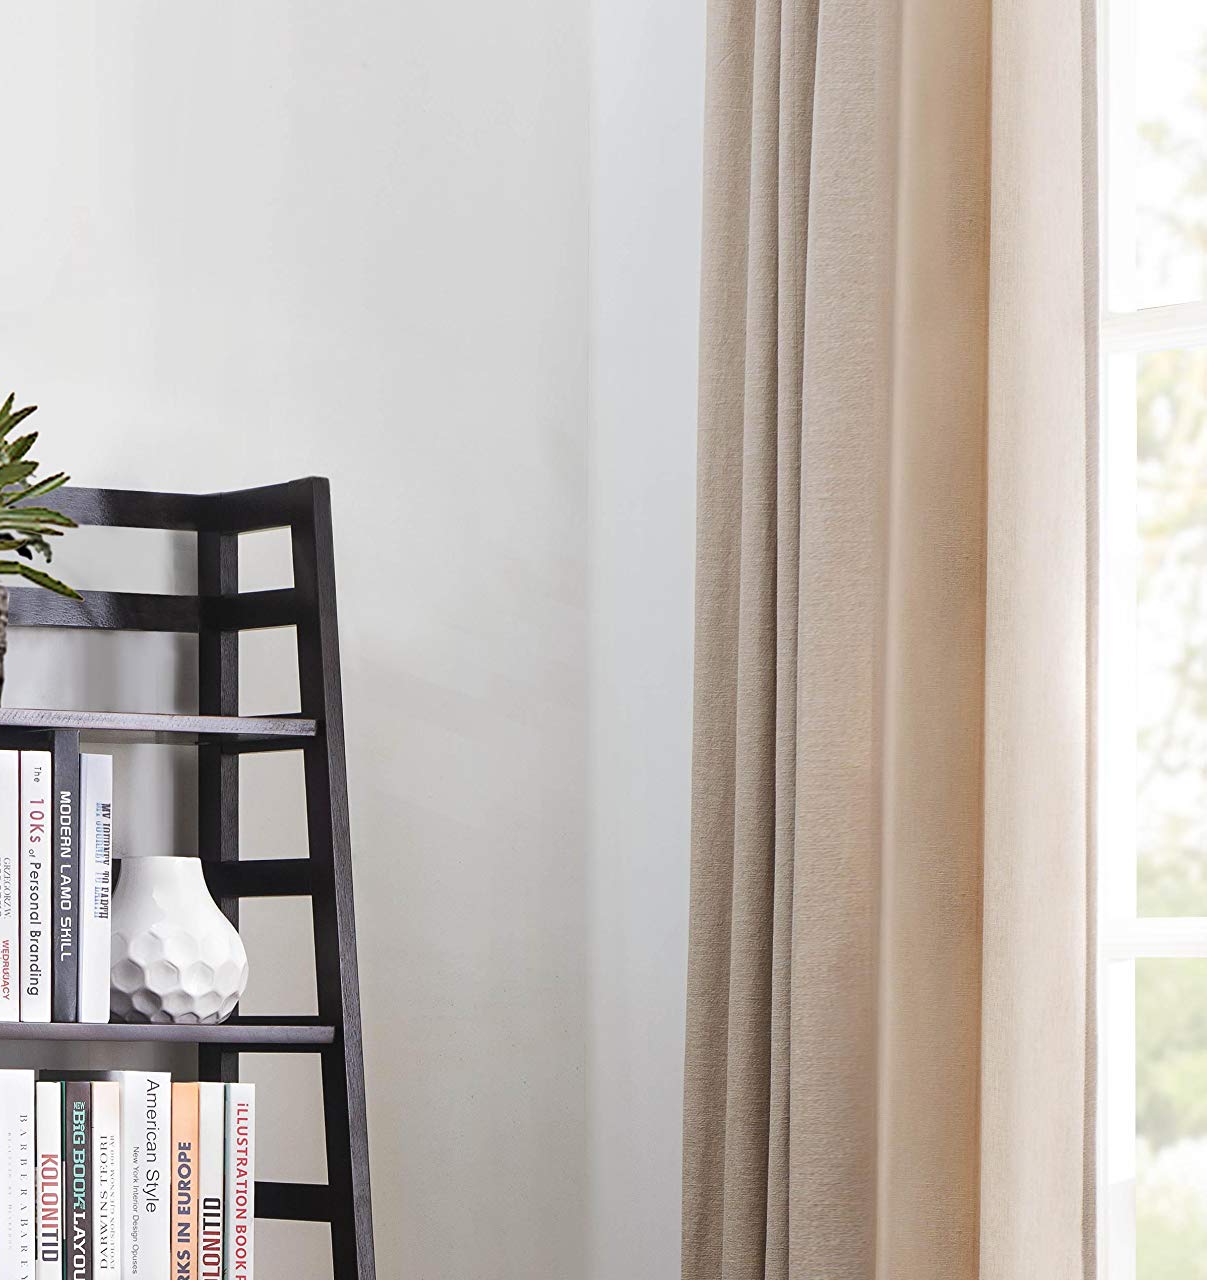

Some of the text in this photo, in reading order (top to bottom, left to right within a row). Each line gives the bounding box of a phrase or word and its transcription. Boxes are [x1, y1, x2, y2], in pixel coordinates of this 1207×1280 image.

[33, 766, 42, 783] The
[29, 862, 42, 925] Personal
[60, 790, 73, 962] MODERN LAMO SKILL
[26, 930, 42, 996] Branding
[73, 1148, 86, 1210] BOOK
[142, 1079, 160, 1213] American Style
[177, 1142, 192, 1215] EUROPE
[41, 1154, 59, 1262] KOLONITID
[99, 1135, 108, 1269] DARWINS TEORI
[130, 1146, 140, 1274] New York Interior Design Opuses
[177, 1222, 191, 1243] IN
[235, 1225, 247, 1270] BOOK
